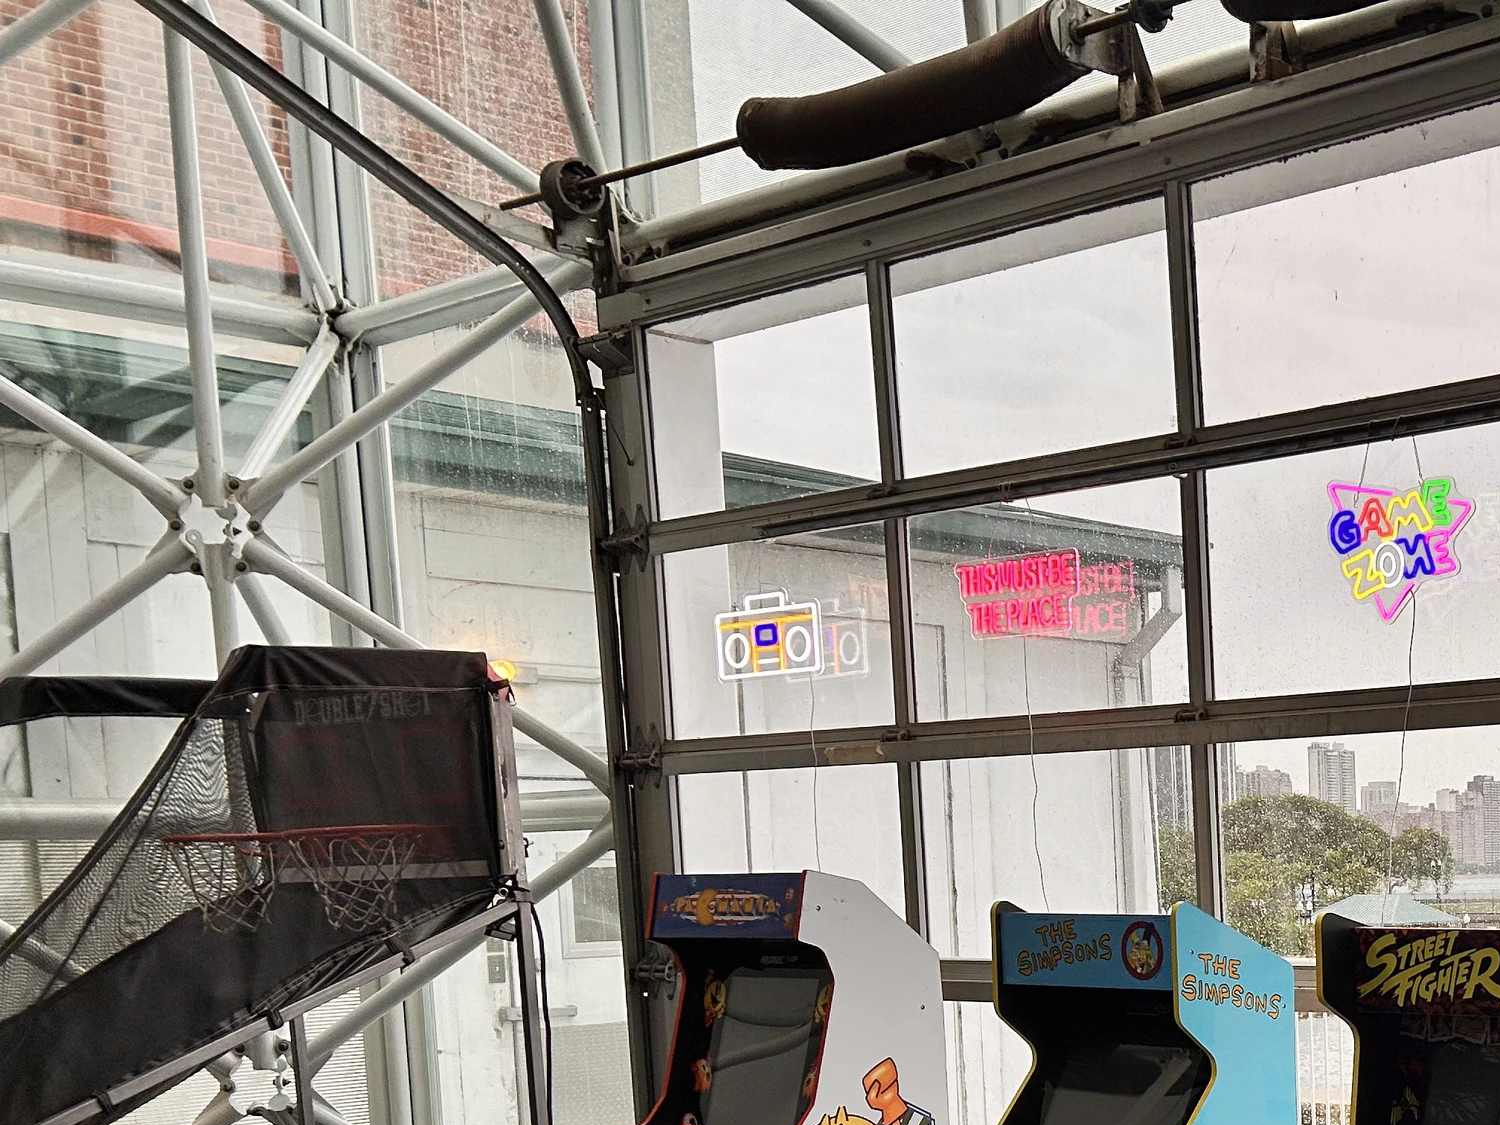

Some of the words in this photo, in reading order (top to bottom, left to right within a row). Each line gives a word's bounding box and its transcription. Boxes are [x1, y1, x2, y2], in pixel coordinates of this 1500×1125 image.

[1330, 478, 1451, 553] GAME
[960, 562, 996, 597] THIS
[997, 556, 1047, 594] MUST
[1048, 551, 1076, 587] BE
[1342, 530, 1455, 600] ZONE
[967, 600, 1007, 635] THE
[1006, 592, 1068, 632] PLACE
[1017, 933, 1113, 976] SIMPSONS
[1035, 918, 1077, 947] THE
[1198, 952, 1242, 980] THE
[1356, 930, 1460, 998] STREET
[1181, 974, 1282, 1020] SIMPSONS
